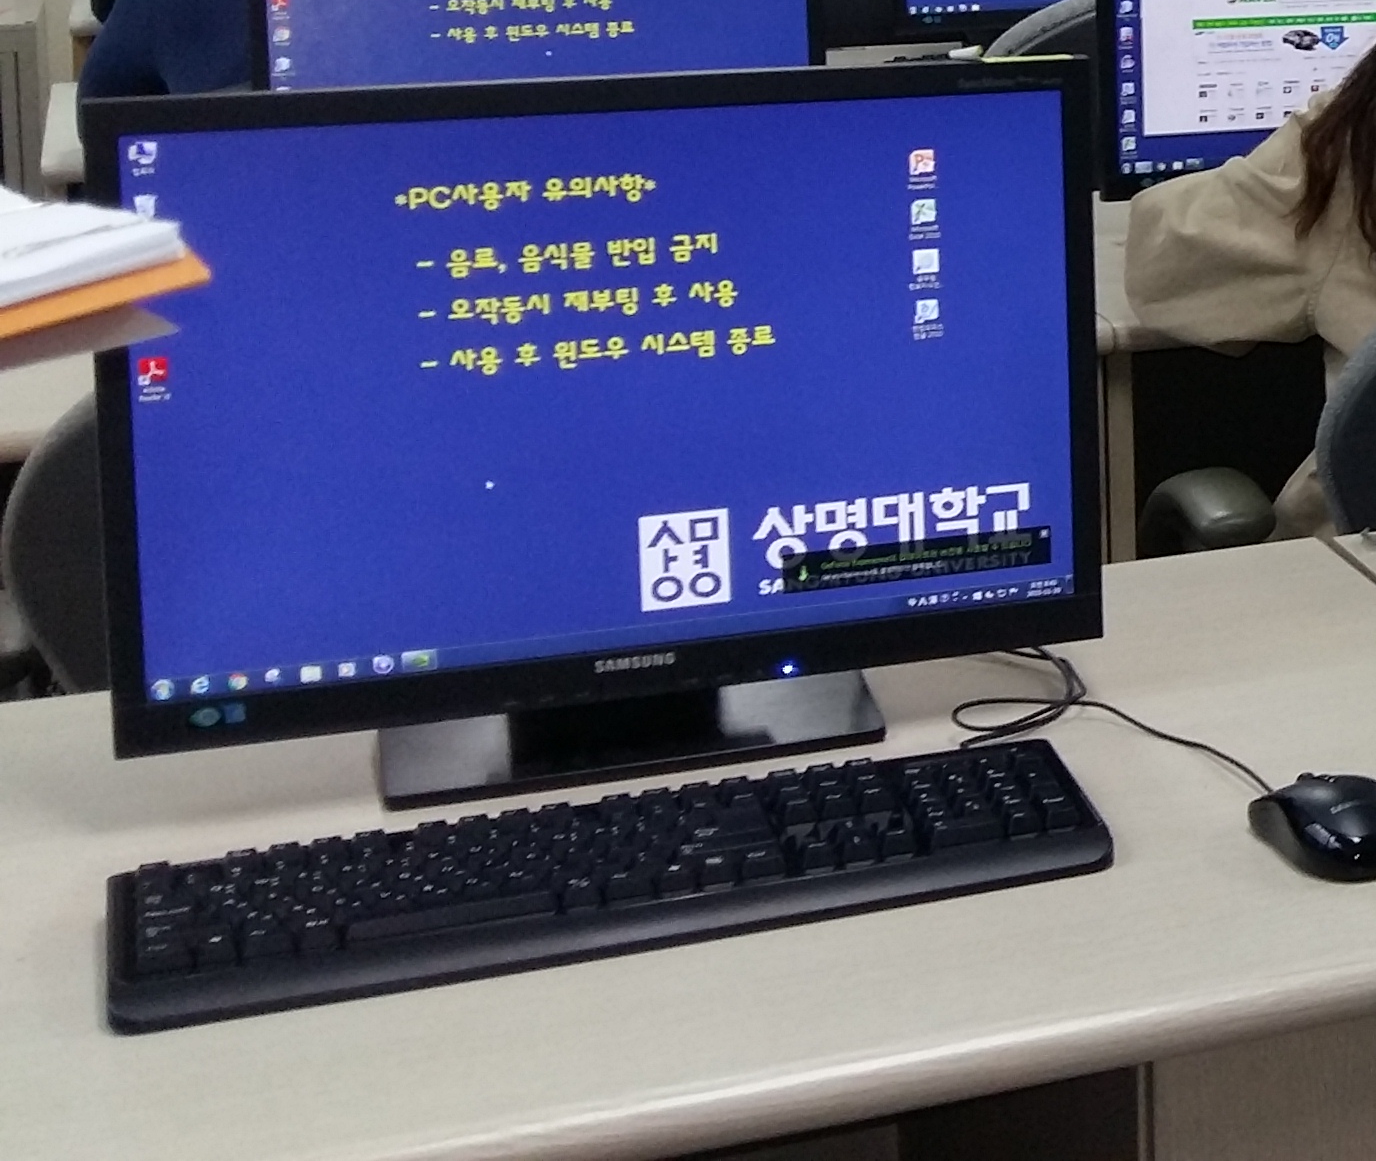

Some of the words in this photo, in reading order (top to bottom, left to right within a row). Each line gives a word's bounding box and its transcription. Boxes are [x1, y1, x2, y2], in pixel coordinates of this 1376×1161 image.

[447, 27, 477, 44] 사용
[484, 26, 498, 39] 후
[506, 24, 550, 42] 윈도우
[556, 22, 599, 38] 시스템
[606, 21, 634, 38] 종료
[446, 247, 507, 277] 음료,
[518, 243, 595, 272] 음식물
[607, 237, 655, 266] 반입
[669, 233, 718, 262] 금지
[447, 294, 551, 324] 오작동시
[564, 287, 639, 315] 재부팅
[652, 284, 677, 306] 후
[688, 280, 738, 306] 사용
[450, 347, 502, 375] 사용
[515, 343, 541, 366] 후
[553, 337, 629, 368] 윈도우
[641, 330, 716, 358] 시스템
[727, 326, 776, 354] 종료
[752, 481, 1031, 570] 상명대학교
[593, 651, 676, 675] SAMSUNG
